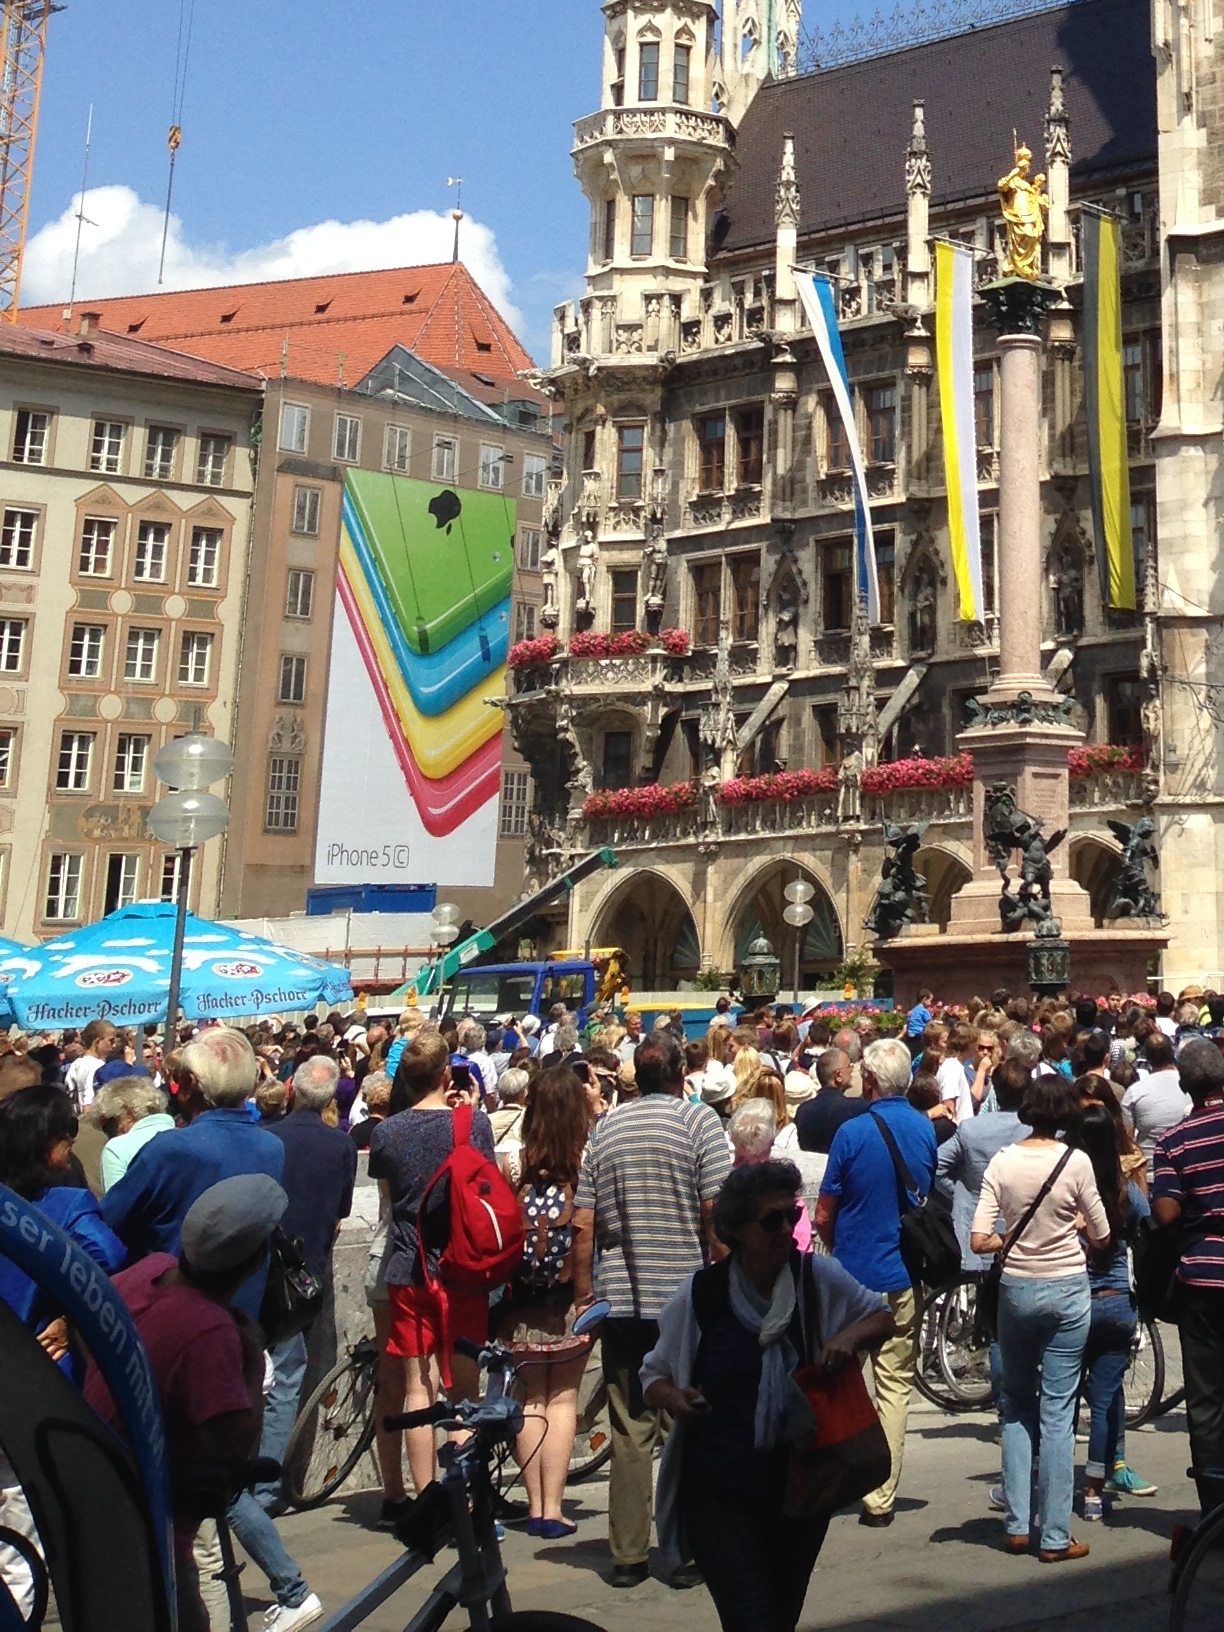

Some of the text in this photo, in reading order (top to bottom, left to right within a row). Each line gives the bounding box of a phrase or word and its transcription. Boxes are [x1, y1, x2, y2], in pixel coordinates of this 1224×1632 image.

[327, 843, 378, 867] iPhone
[28, 998, 161, 1023] Hacker-Pschorr
[197, 986, 307, 1013] Hacker-Pschorr
[60, 1243, 128, 1355] leben
